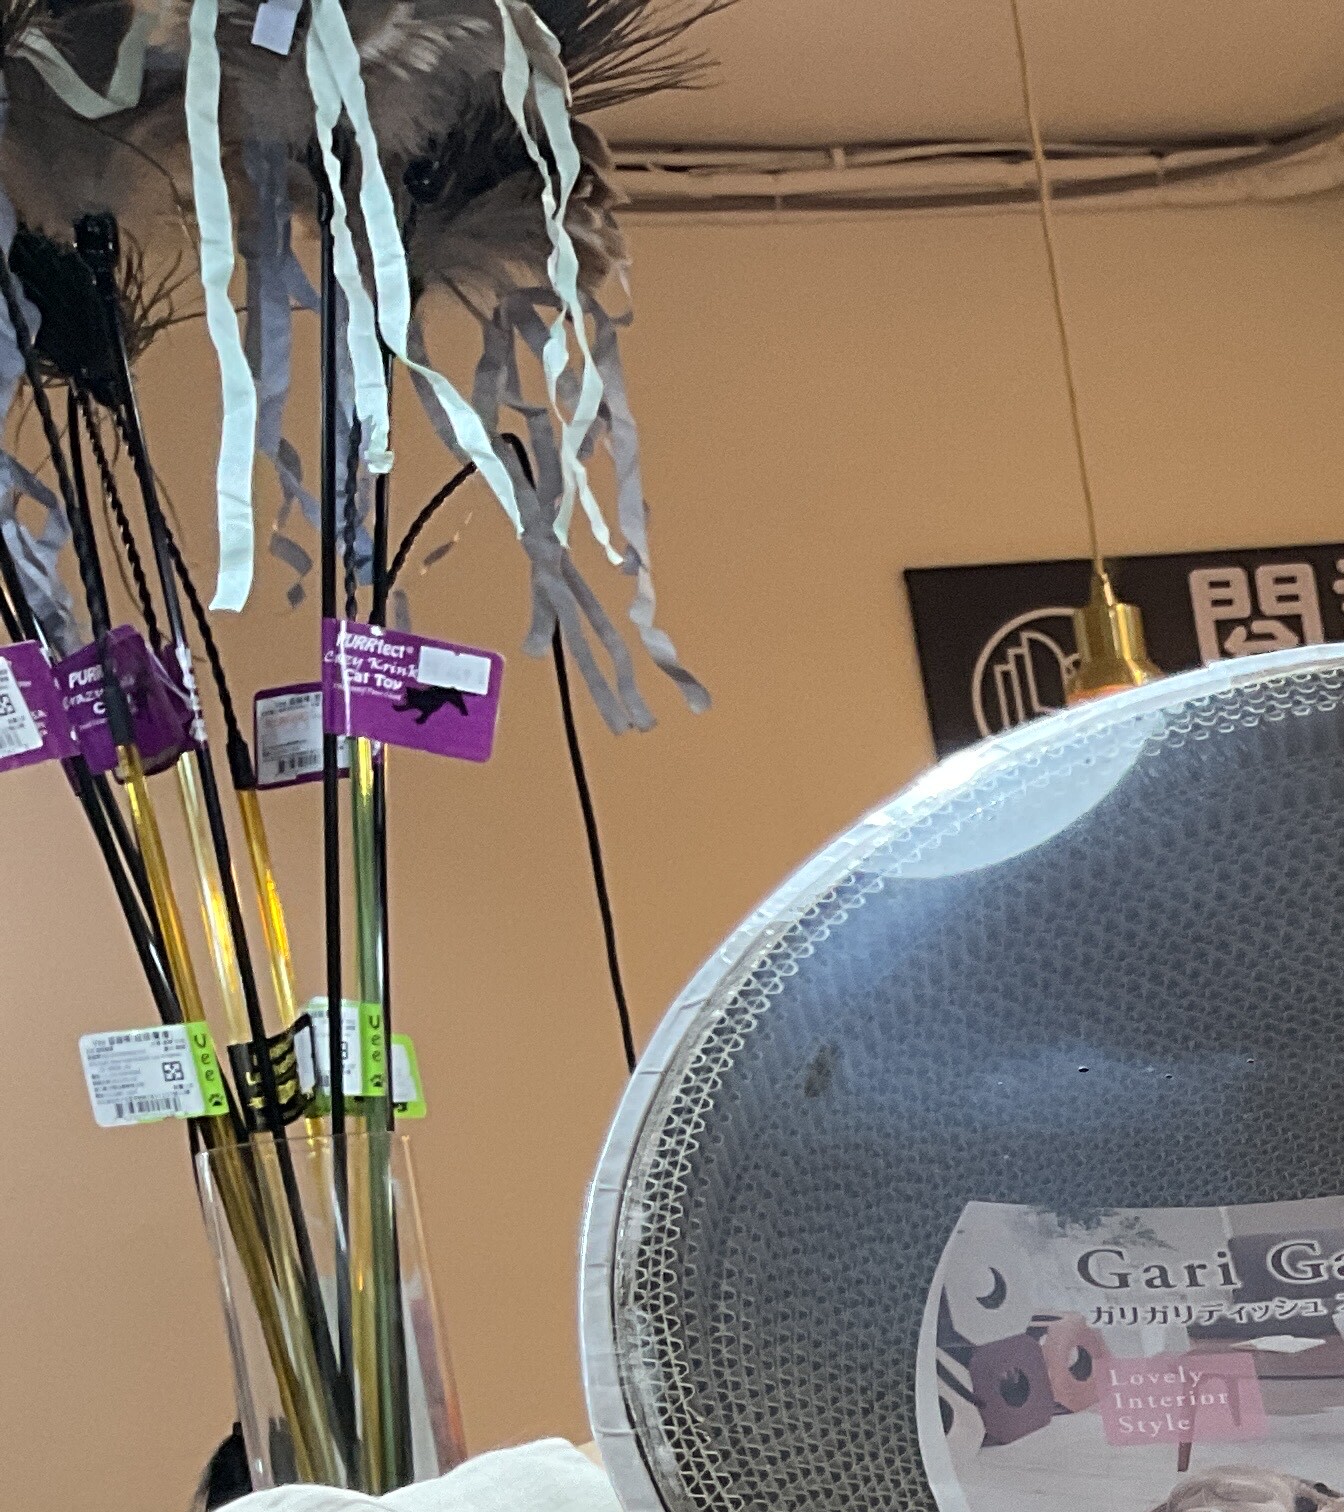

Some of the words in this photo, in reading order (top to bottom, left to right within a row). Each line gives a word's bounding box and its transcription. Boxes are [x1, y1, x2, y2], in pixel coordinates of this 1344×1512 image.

[1077, 1248, 1243, 1290] Gari
[1109, 1366, 1203, 1390] Lovely
[1113, 1391, 1229, 1409] Interior
[1117, 1413, 1192, 1438] Style
